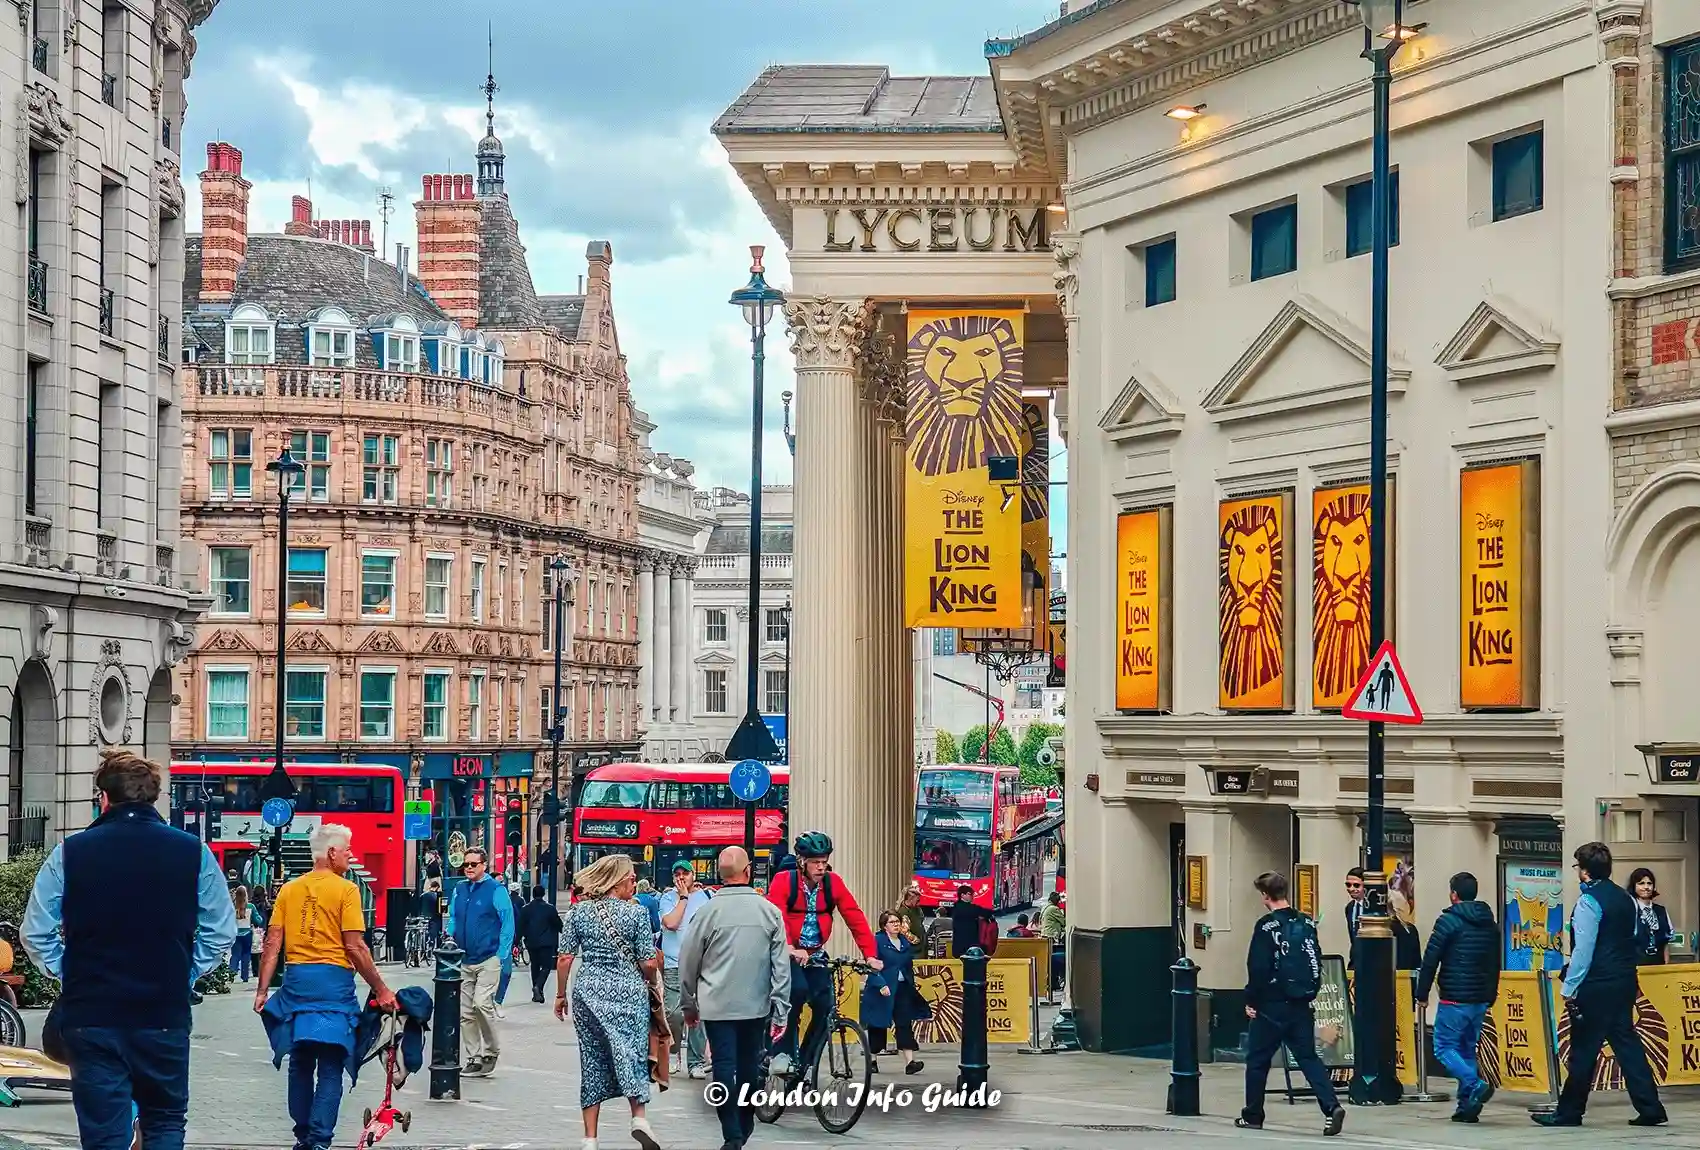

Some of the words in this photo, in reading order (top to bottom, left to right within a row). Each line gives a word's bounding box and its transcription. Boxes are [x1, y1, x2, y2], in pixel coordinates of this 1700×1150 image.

[823, 207, 1049, 251] LYCEUM
[940, 489, 984, 504] Disney
[942, 509, 984, 529] THE
[1476, 512, 1504, 531] Disney
[934, 538, 990, 572] LION
[1477, 536, 1504, 561] THE
[1128, 569, 1147, 590] THE
[929, 576, 997, 614] KING
[1472, 573, 1508, 616] LION
[1125, 600, 1150, 635] LION
[1469, 619, 1513, 668] KING
[1122, 639, 1153, 677] KING
[453, 757, 484, 776] LEON
[1670, 759, 1692, 768] Grand
[1670, 768, 1689, 777] Circle
[1223, 782, 1242, 790] Office
[586, 823, 617, 832] Smithfield
[624, 823, 637, 835] 59
[1534, 841, 1562, 851] THEATR
[1334, 998, 1344, 1010] of
[1507, 1003, 1524, 1018] THE
[1682, 996, 1700, 1009] TH
[988, 1017, 1011, 1028] ING
[1505, 1023, 1529, 1049] LION
[1505, 1051, 1533, 1078] KING
